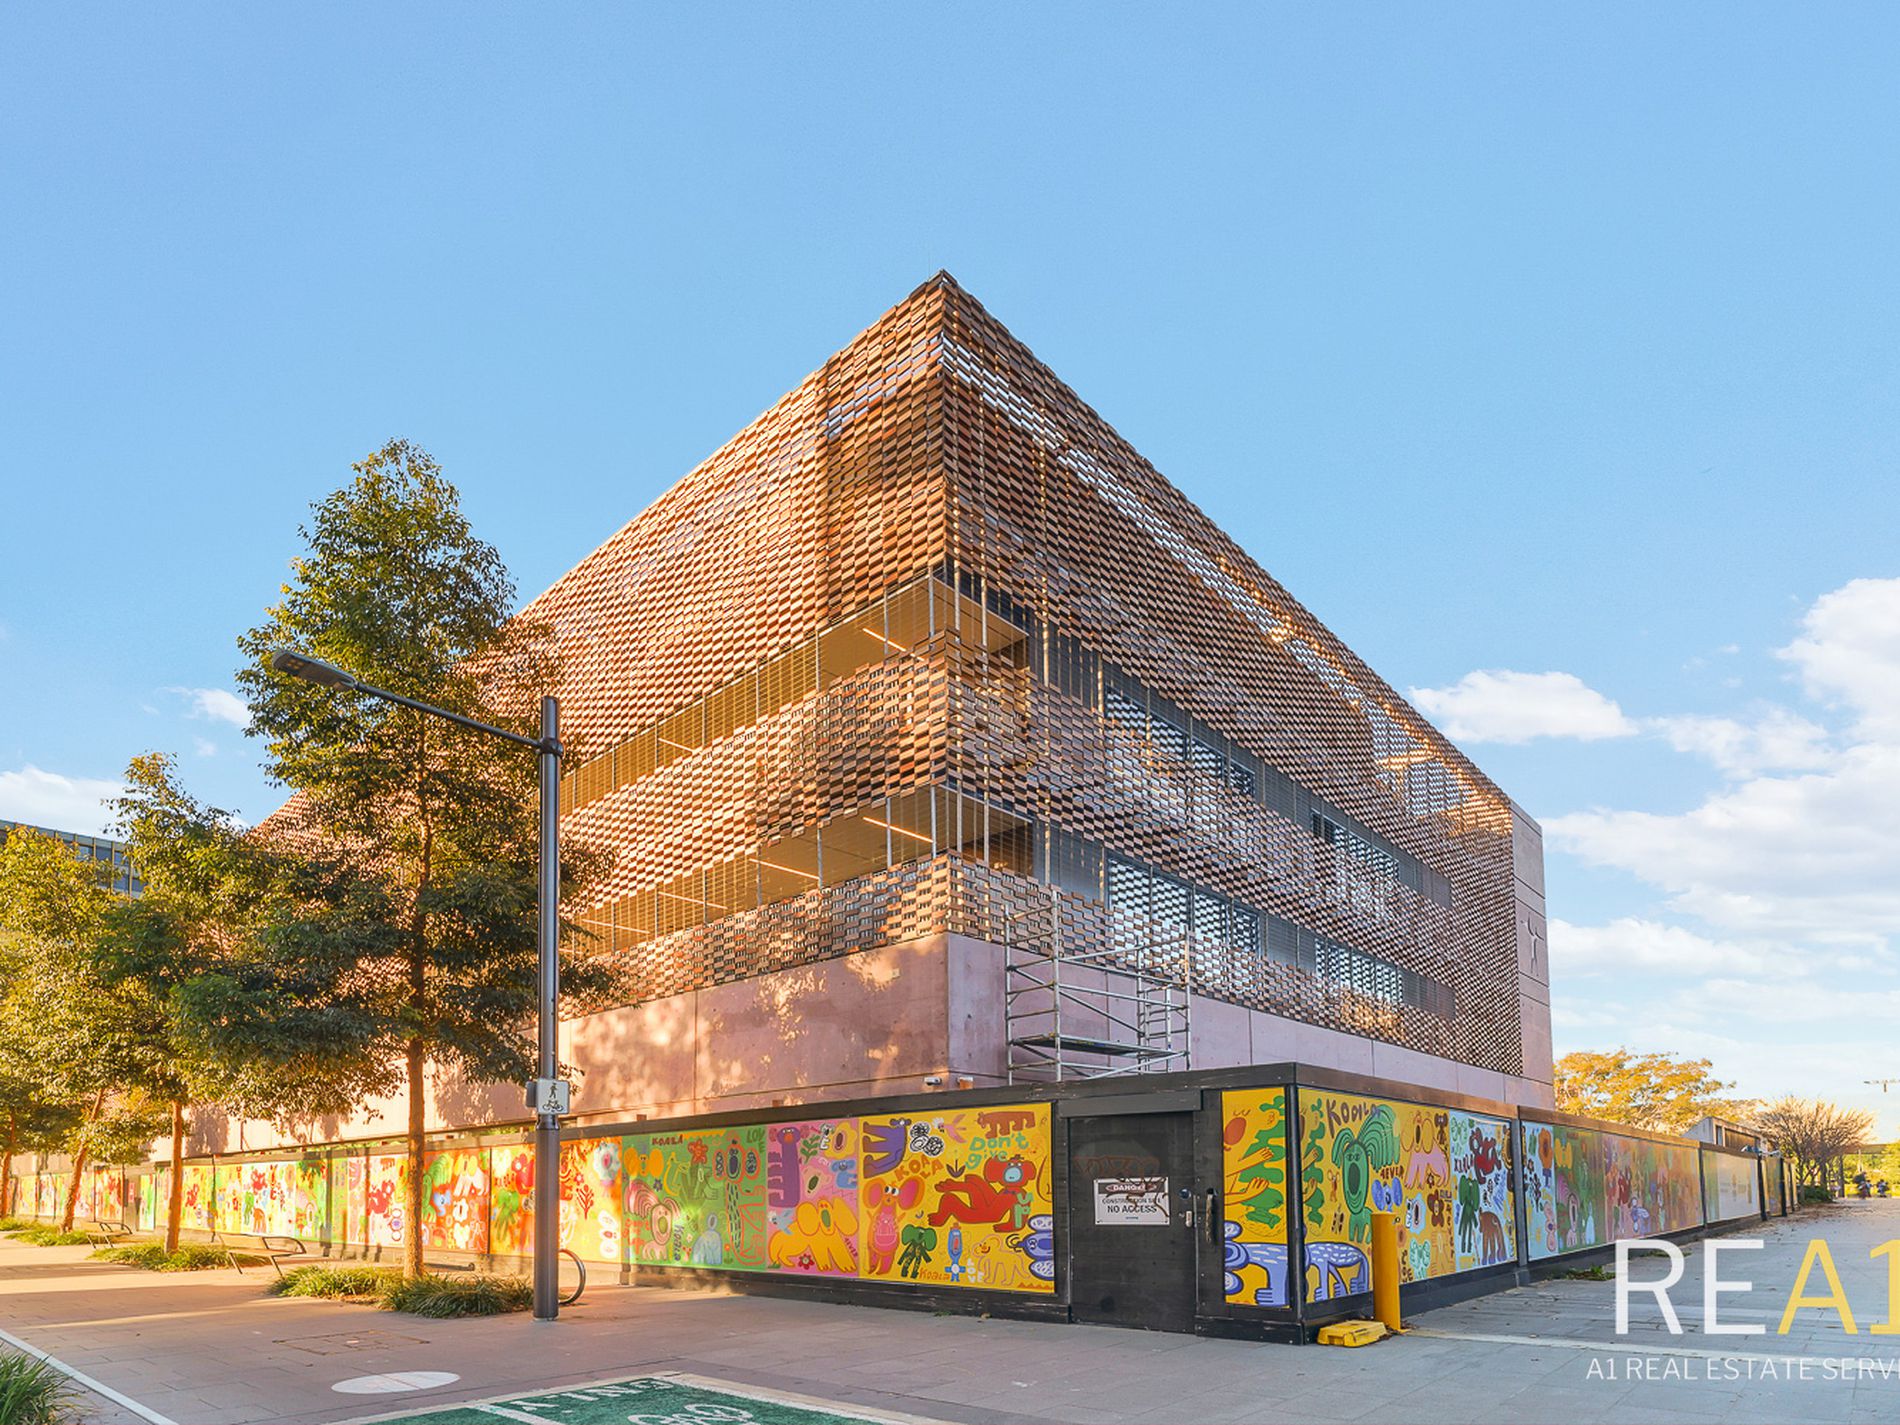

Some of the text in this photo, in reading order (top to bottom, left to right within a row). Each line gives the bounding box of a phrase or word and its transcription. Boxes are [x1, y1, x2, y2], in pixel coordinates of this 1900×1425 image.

[968, 1132, 1029, 1151] Don't
[965, 1150, 1009, 1170] give
[1112, 1182, 1147, 1191] DANG
[1107, 1205, 1157, 1213] NO ACCESS
